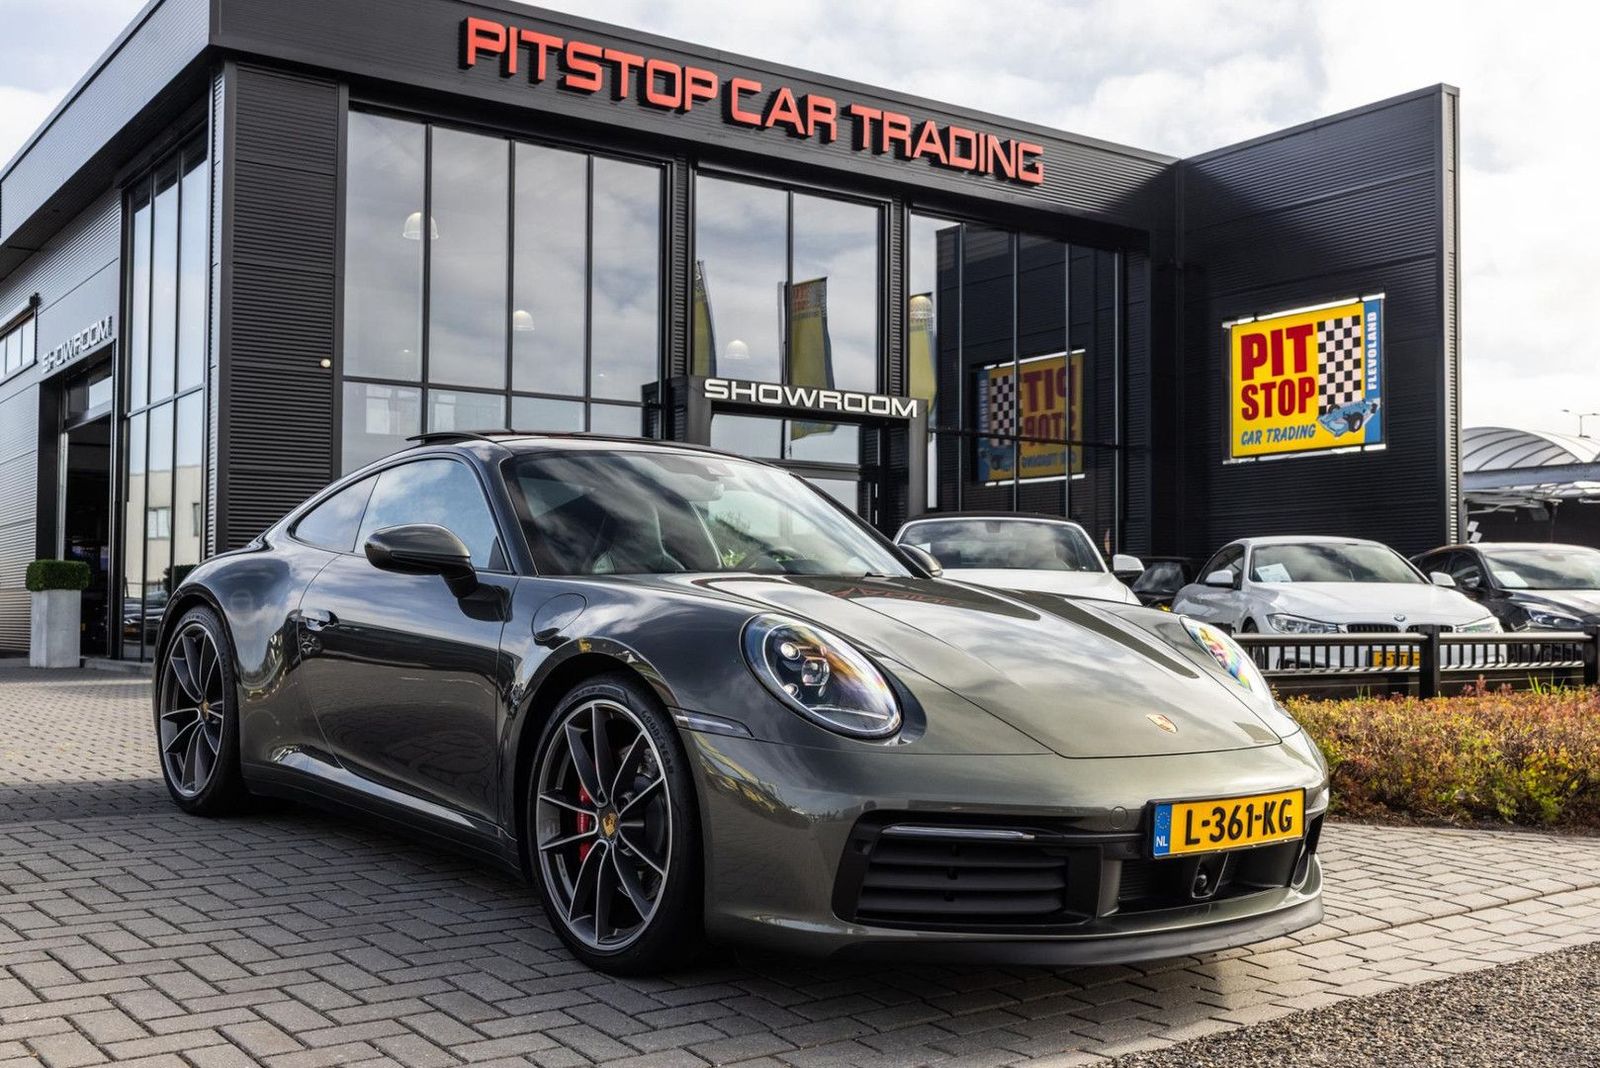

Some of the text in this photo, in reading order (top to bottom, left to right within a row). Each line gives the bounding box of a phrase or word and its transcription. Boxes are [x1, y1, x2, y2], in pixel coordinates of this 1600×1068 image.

[465, 16, 1045, 185] PITSTOP CAR TRADING
[1240, 323, 1314, 381] PIT
[1367, 311, 1377, 391] FLEVOLAND
[704, 378, 918, 418] SHOWROOM
[1240, 376, 1316, 421] STOP
[1240, 423, 1316, 446] CAR TRADING
[1155, 835, 1168, 848] NL
[1184, 798, 1293, 846] L-361-KG
